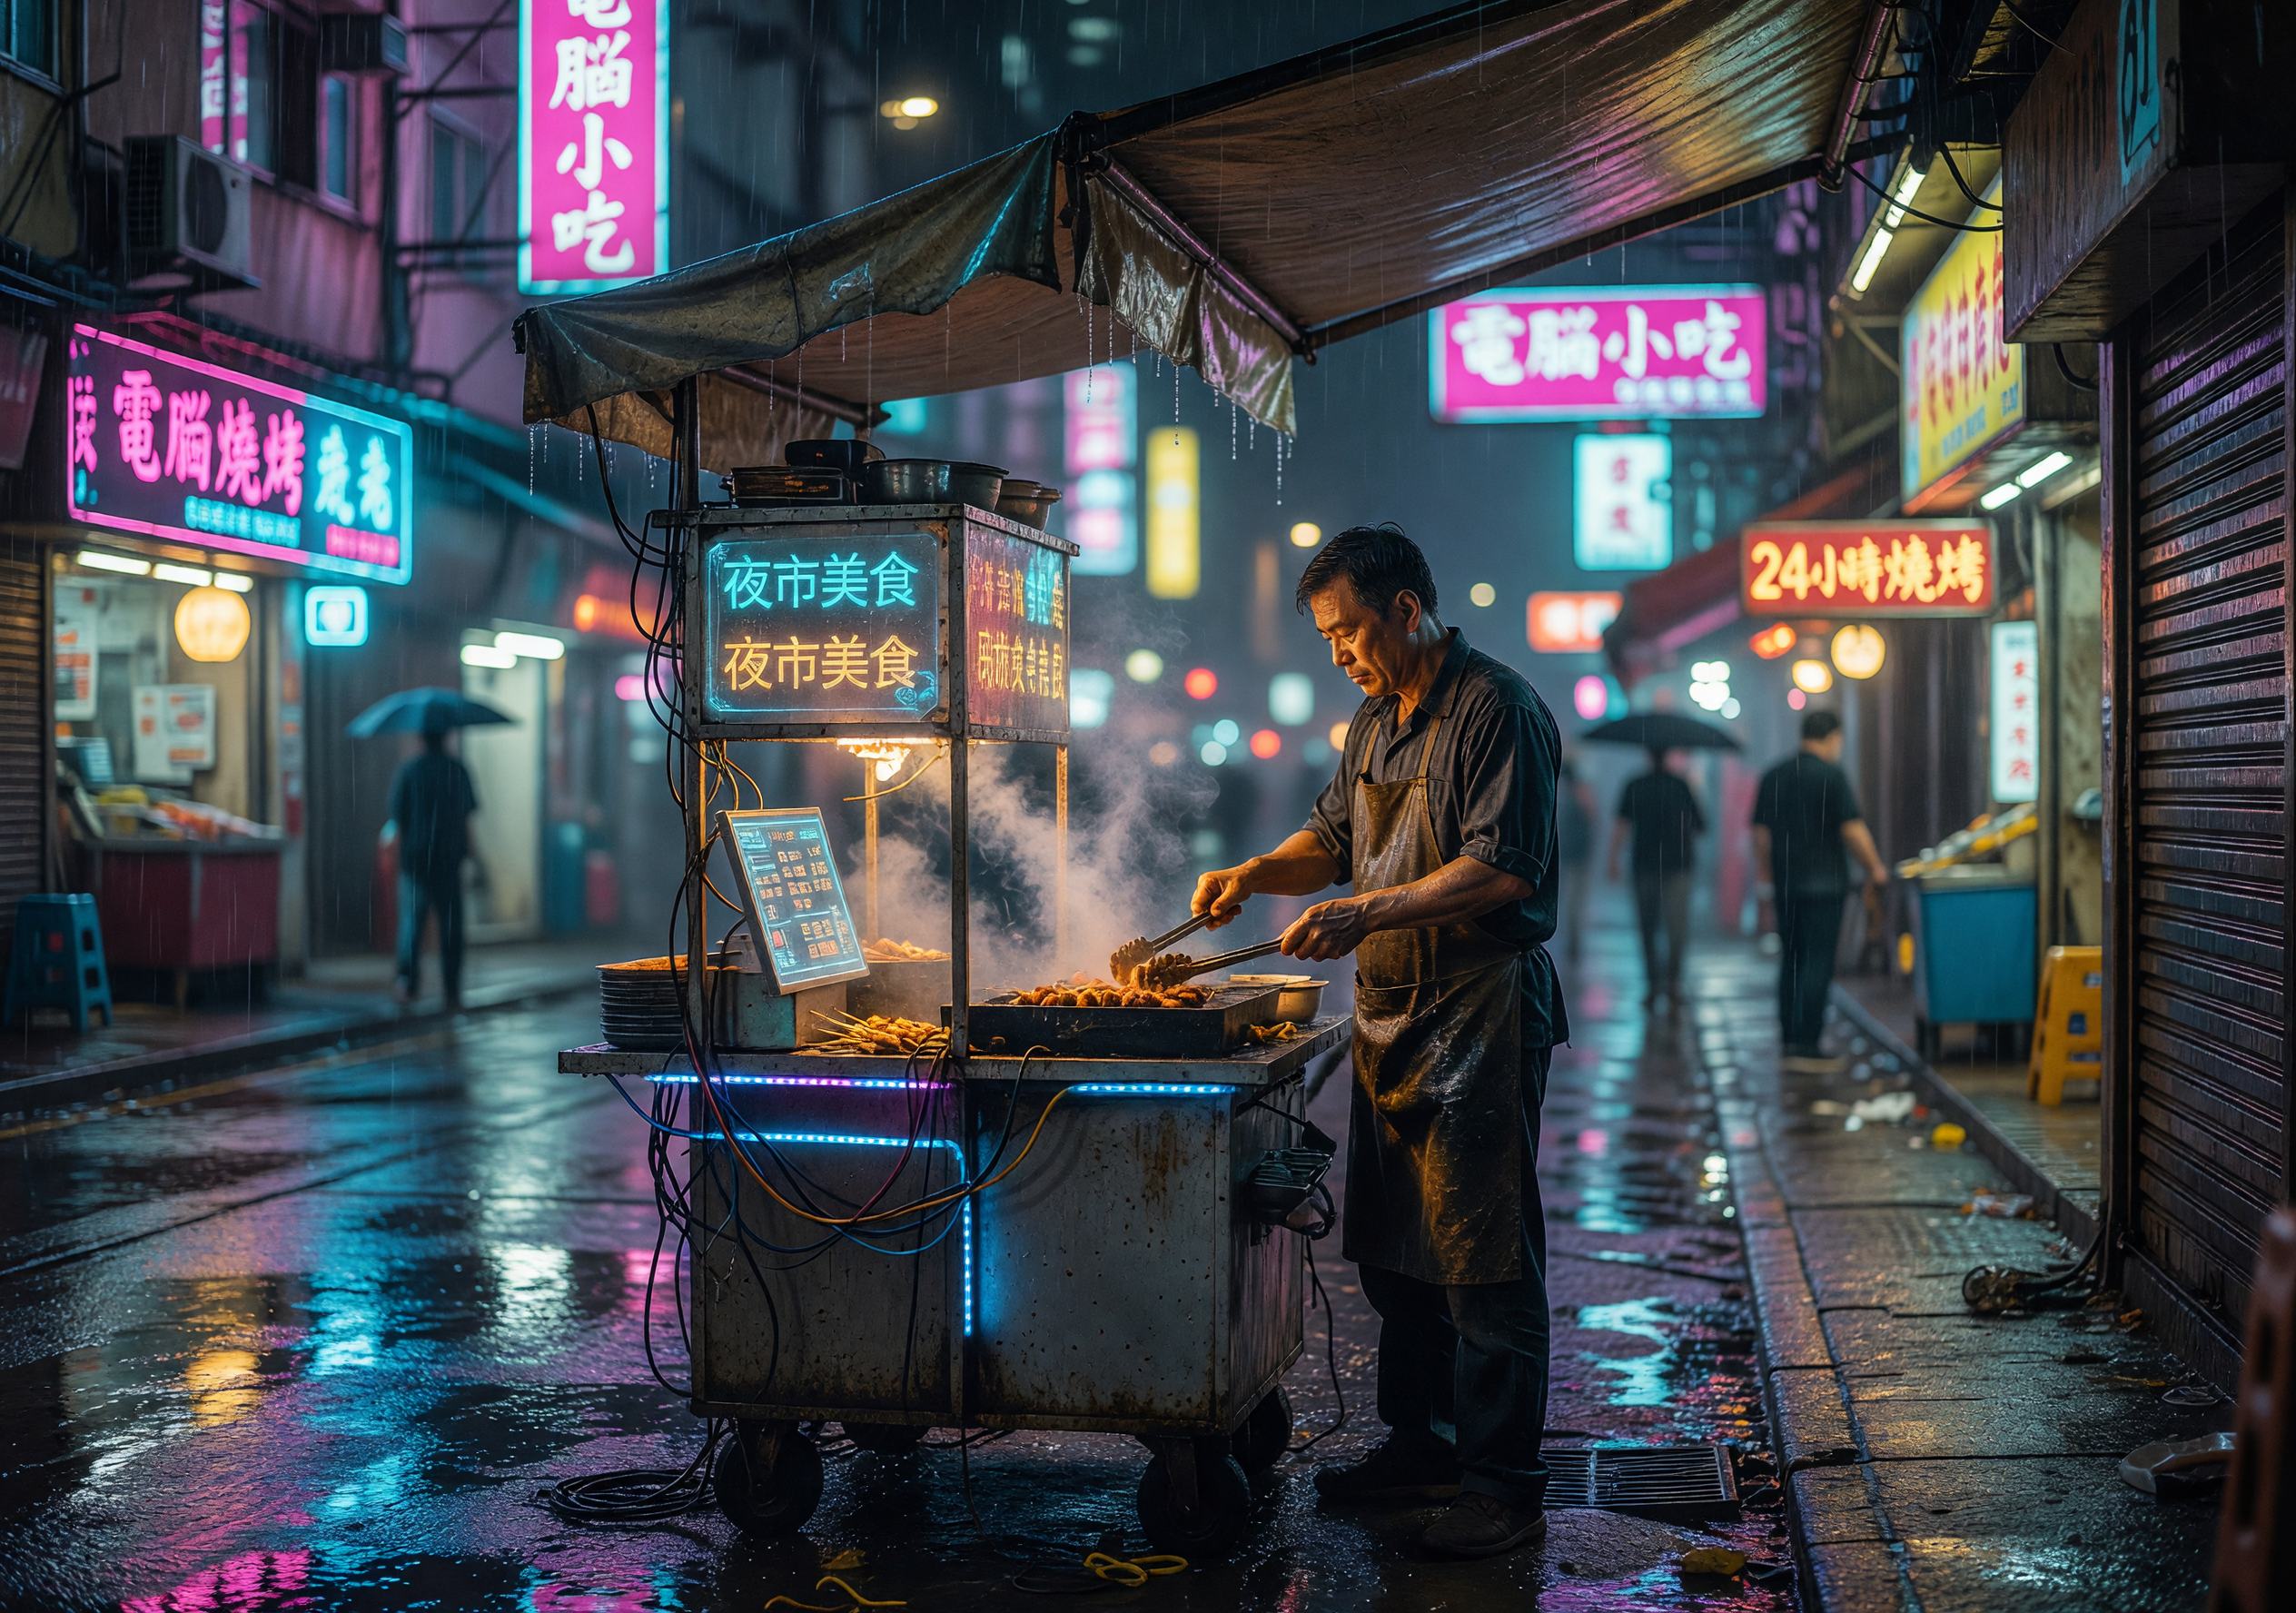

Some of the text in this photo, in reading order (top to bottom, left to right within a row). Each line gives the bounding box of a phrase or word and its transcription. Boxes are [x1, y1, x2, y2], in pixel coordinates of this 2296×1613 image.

[723, 551, 919, 609] 夜市美食
[723, 635, 919, 691] 夜市美食
